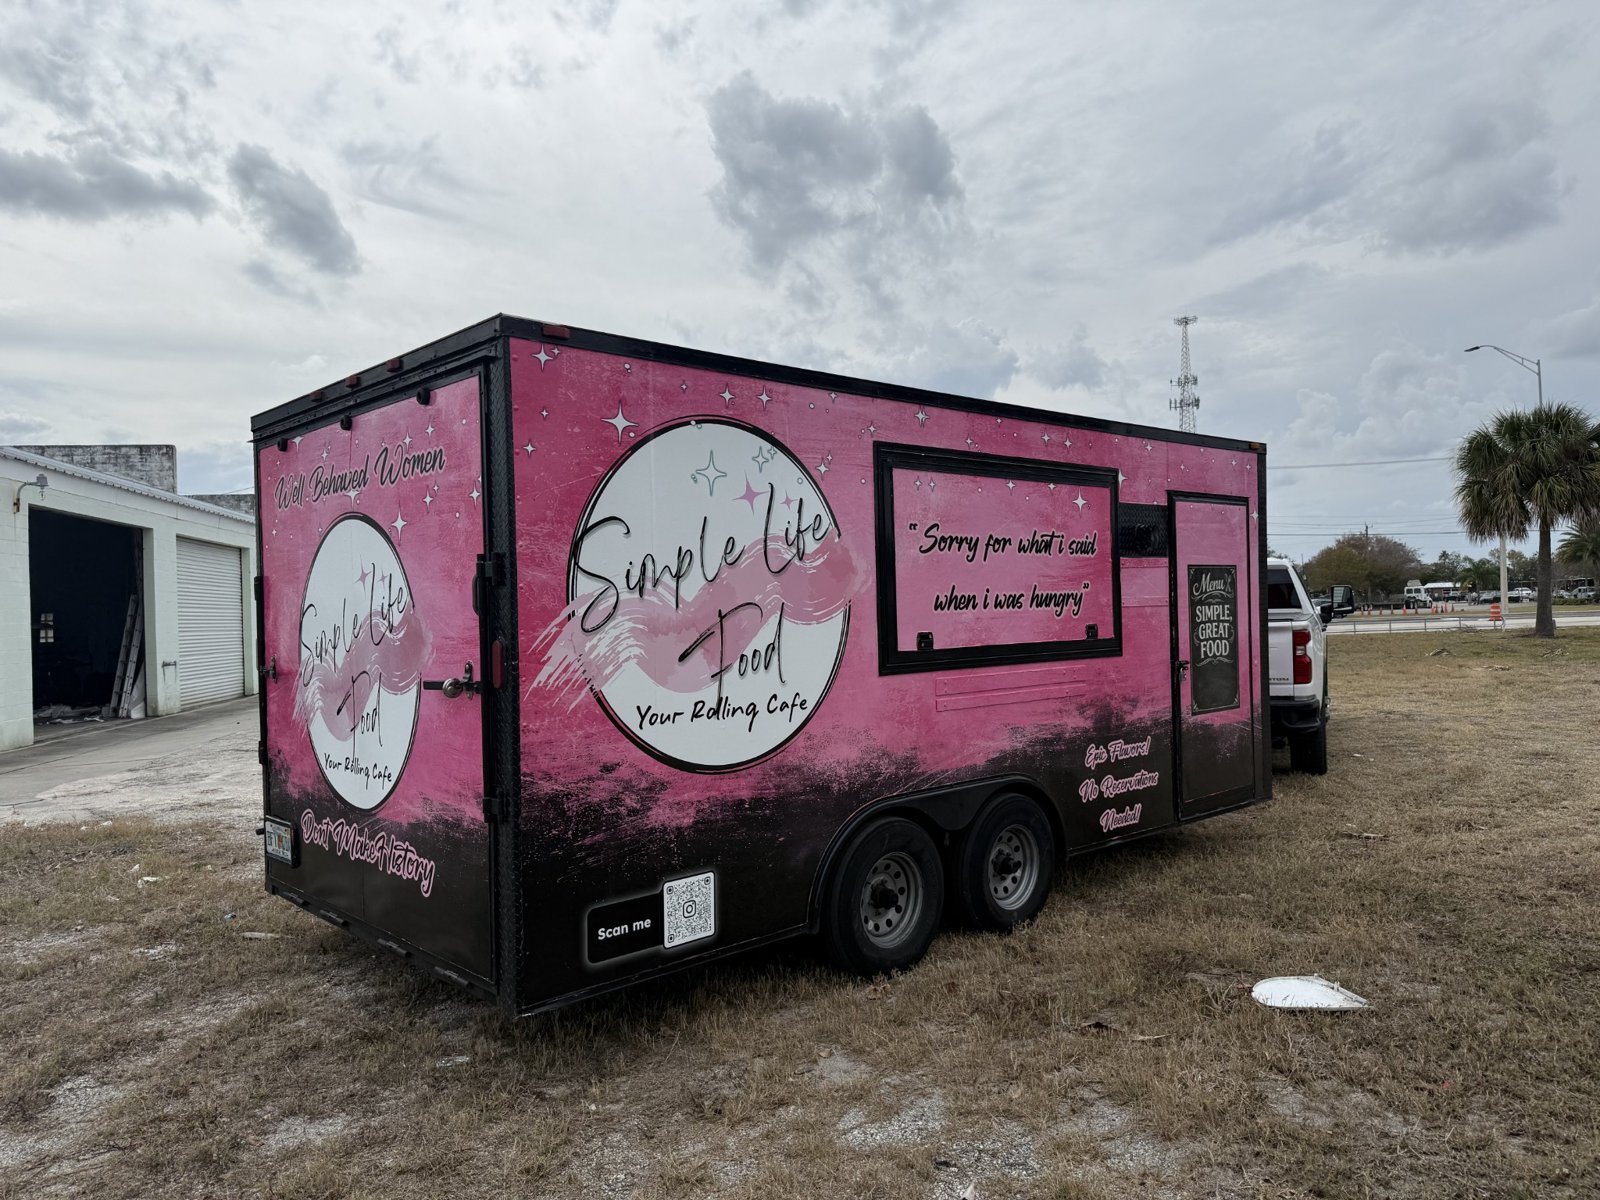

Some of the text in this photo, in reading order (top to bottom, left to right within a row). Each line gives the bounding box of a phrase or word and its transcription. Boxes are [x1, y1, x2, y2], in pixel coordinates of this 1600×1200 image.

[274, 444, 446, 510] Well Behaved Women
[573, 482, 832, 633] Simple Life
[984, 533, 1013, 563] for
[1018, 530, 1059, 556] what
[1068, 531, 1098, 556] said
[933, 585, 979, 612] when
[982, 587, 991, 611] i
[993, 591, 1025, 611] was
[1192, 572, 1226, 596] Menu
[300, 562, 407, 688] Simple Life
[1195, 604, 1233, 623] SIMPLE,
[1198, 623, 1230, 640] GREAT
[677, 601, 786, 708] Food
[1200, 640, 1230, 659] FOOD
[336, 670, 383, 762] Food
[636, 692, 808, 733] Your Rolling Cafe
[1084, 735, 1152, 770] Epic Flavors!
[323, 752, 393, 790] Your Rolling Cafe
[1078, 769, 1159, 803] No Reservations
[1099, 802, 1142, 833] Needed!
[300, 808, 332, 851] Dont
[332, 818, 377, 864] Make
[376, 831, 436, 898] History
[597, 918, 652, 940] Scan me
